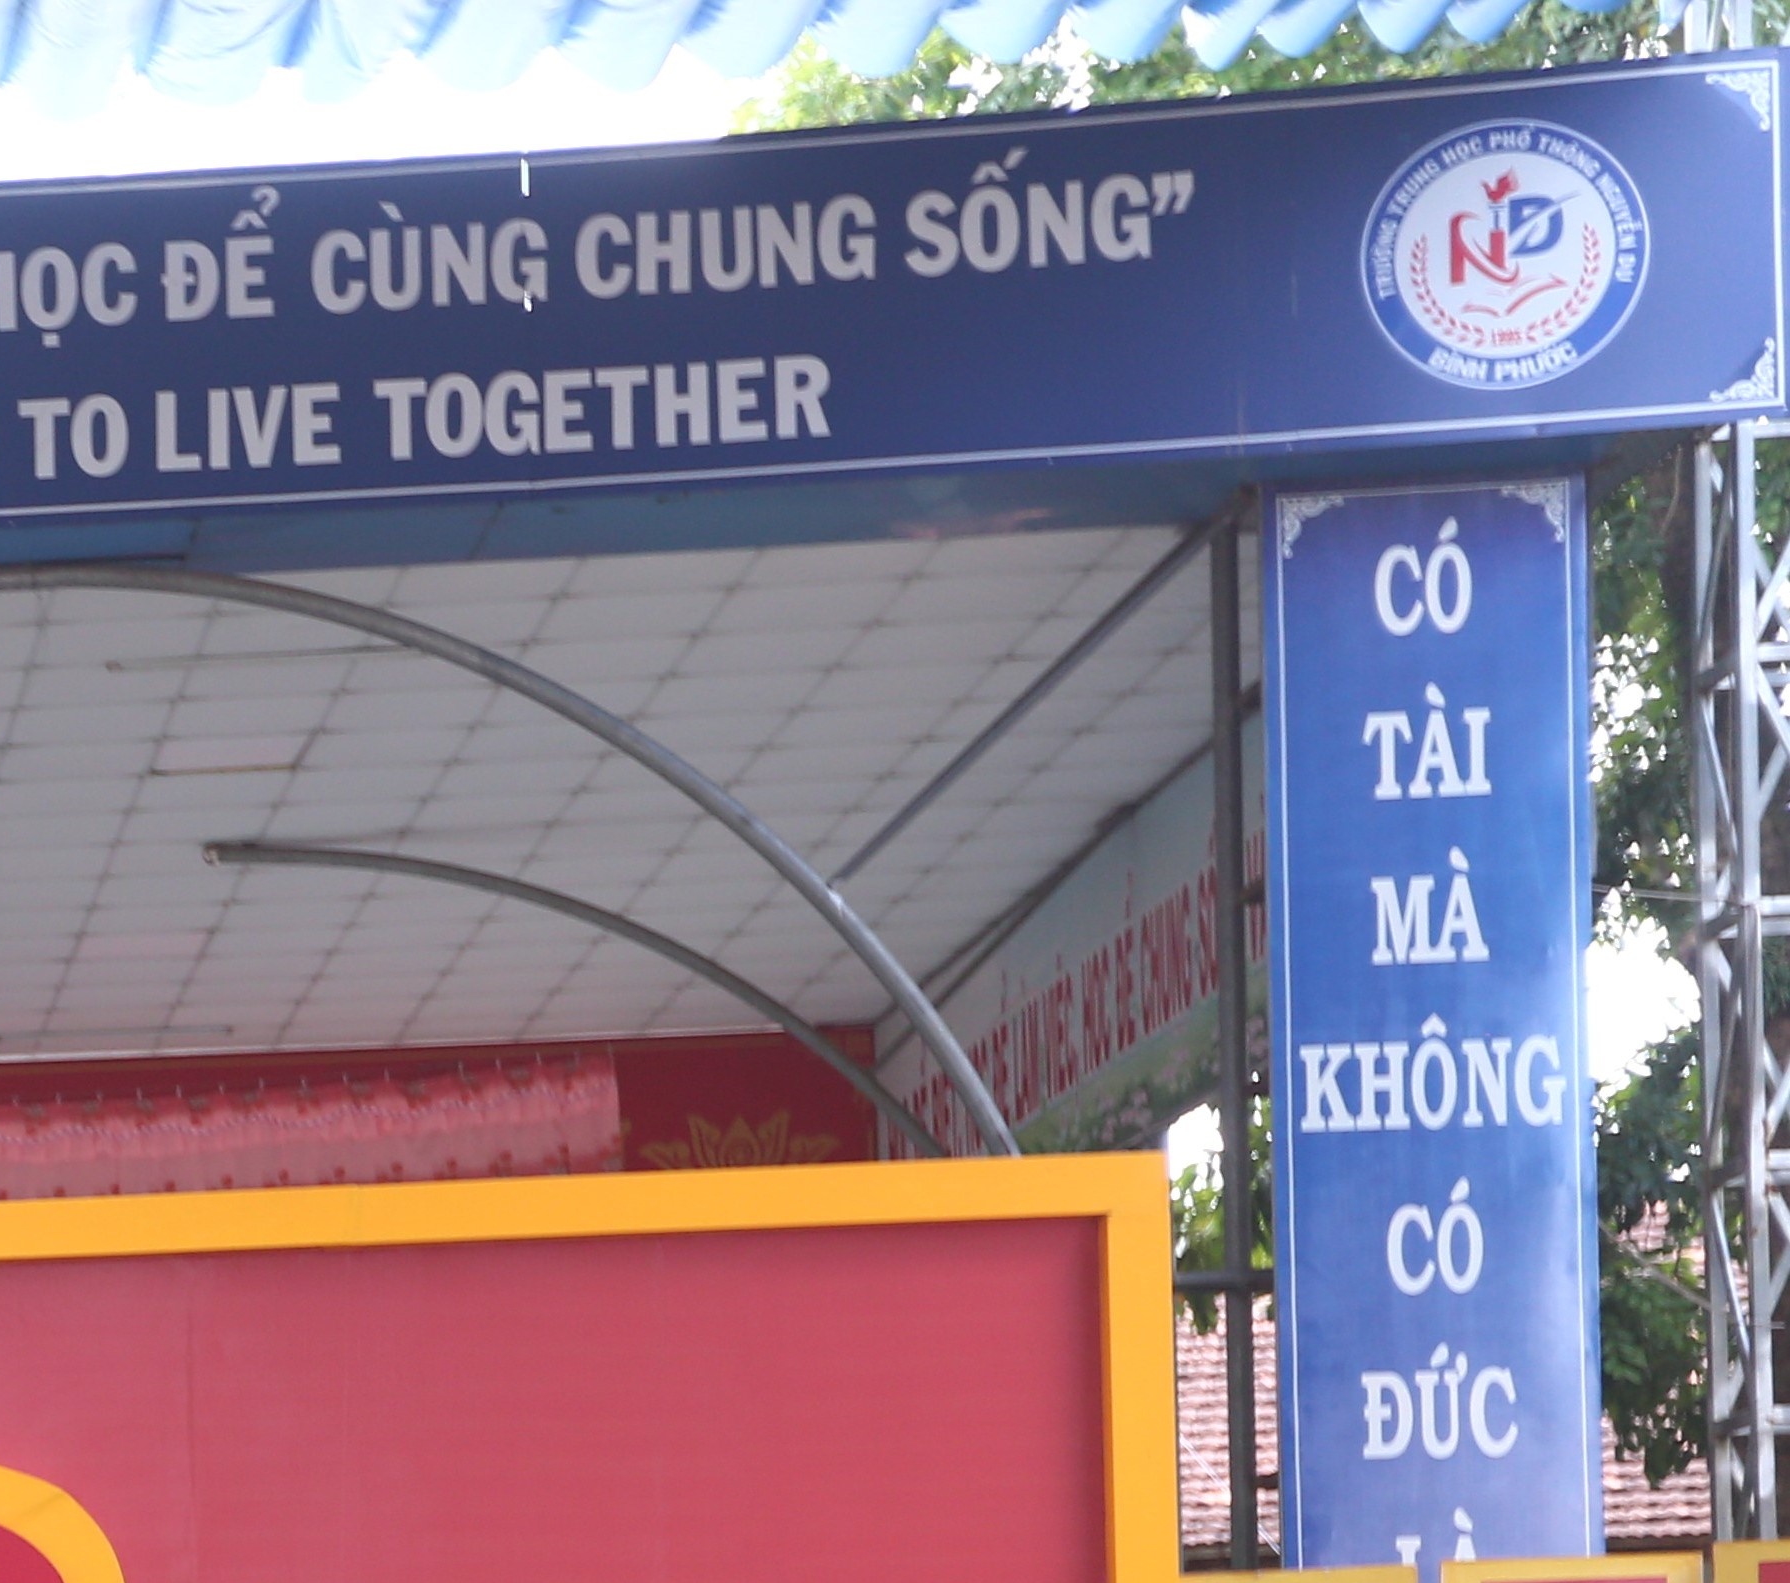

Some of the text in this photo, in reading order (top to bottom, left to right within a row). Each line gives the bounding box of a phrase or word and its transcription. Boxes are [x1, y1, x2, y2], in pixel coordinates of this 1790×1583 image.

[165, 187, 275, 319] ĐỂ
[312, 200, 549, 312] CÙNG
[575, 207, 875, 298] CHUNG
[905, 147, 1194, 281] SỐNG”
[1390, 162, 1440, 216] TRUNG
[21, 392, 130, 480] TO
[156, 381, 340, 470] LIVE
[374, 354, 831, 460] TOGETHER
[1374, 520, 1472, 636] CÓ
[1365, 684, 1492, 798] TÀI
[1372, 847, 1488, 965] MÀ
[1300, 1014, 1566, 1132] KHÔNG
[1388, 1178, 1483, 1295] CÓ
[1363, 1343, 1518, 1460] ĐỨC
